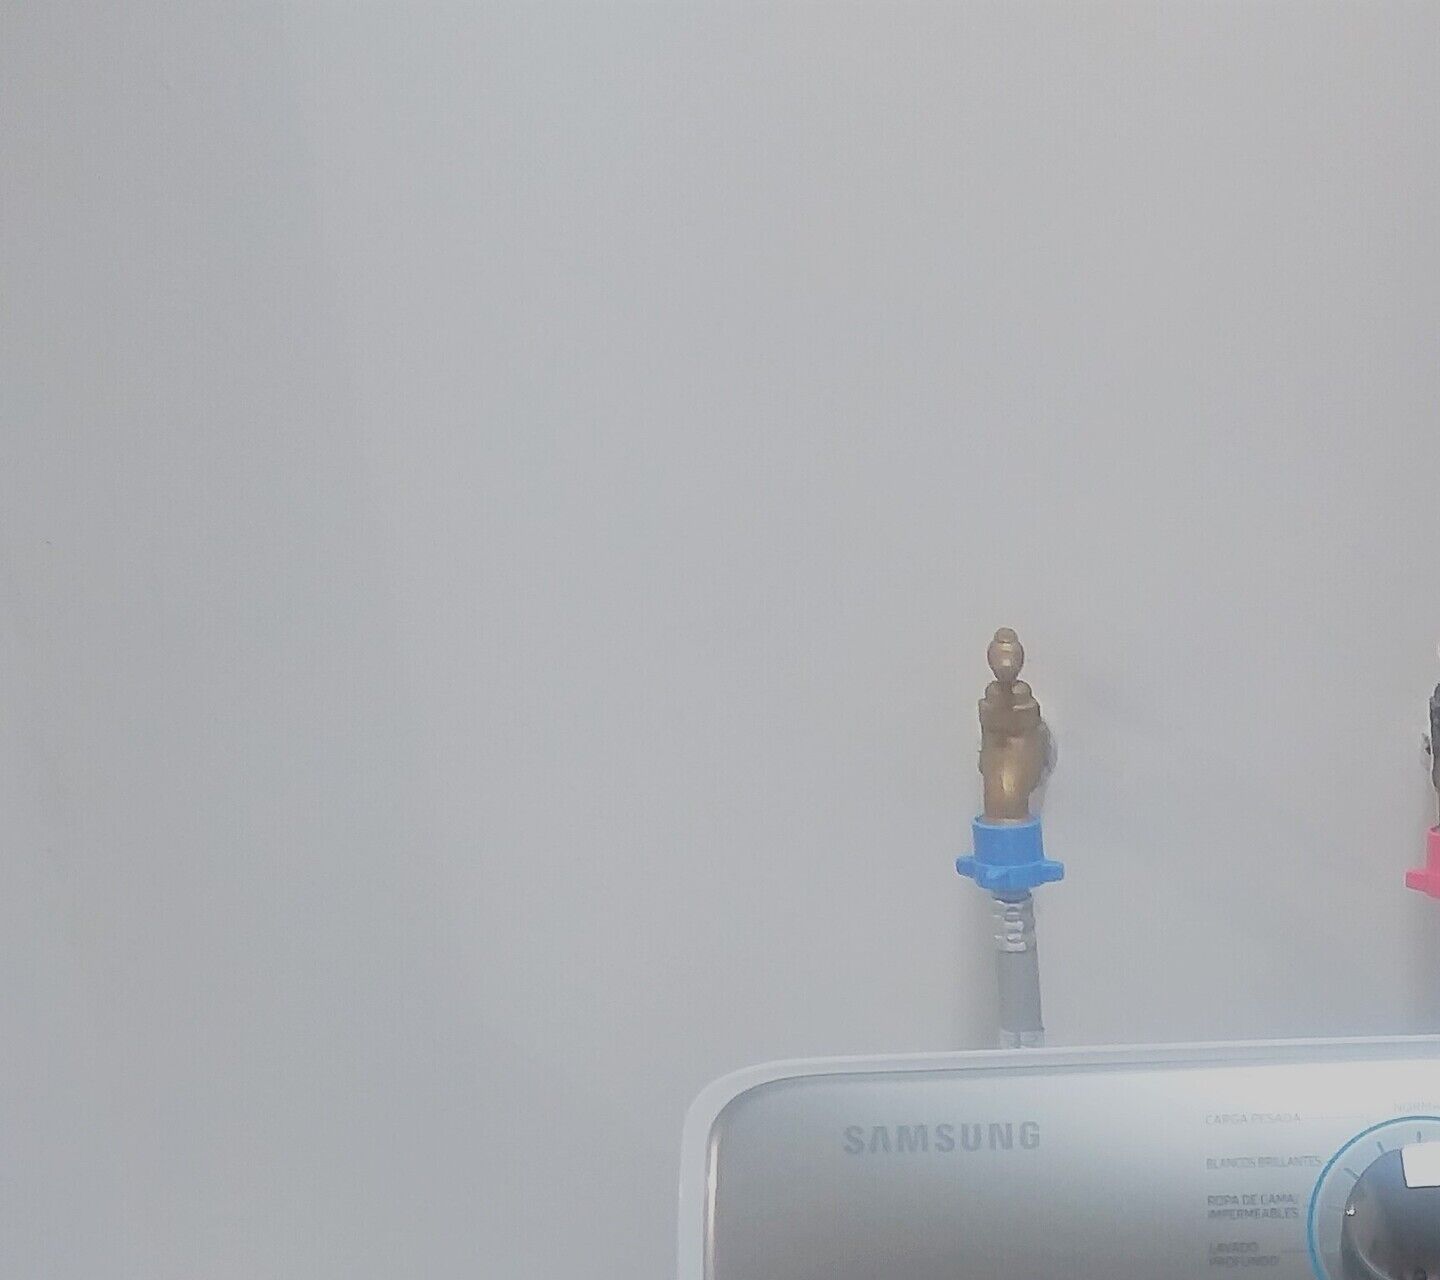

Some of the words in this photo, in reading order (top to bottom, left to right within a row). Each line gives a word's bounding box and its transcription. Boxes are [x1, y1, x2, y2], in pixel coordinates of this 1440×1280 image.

[843, 1121, 1041, 1154] SAMSUNG
[1208, 1195, 1239, 1206] ROPA
[1243, 1194, 1258, 1206] DE
